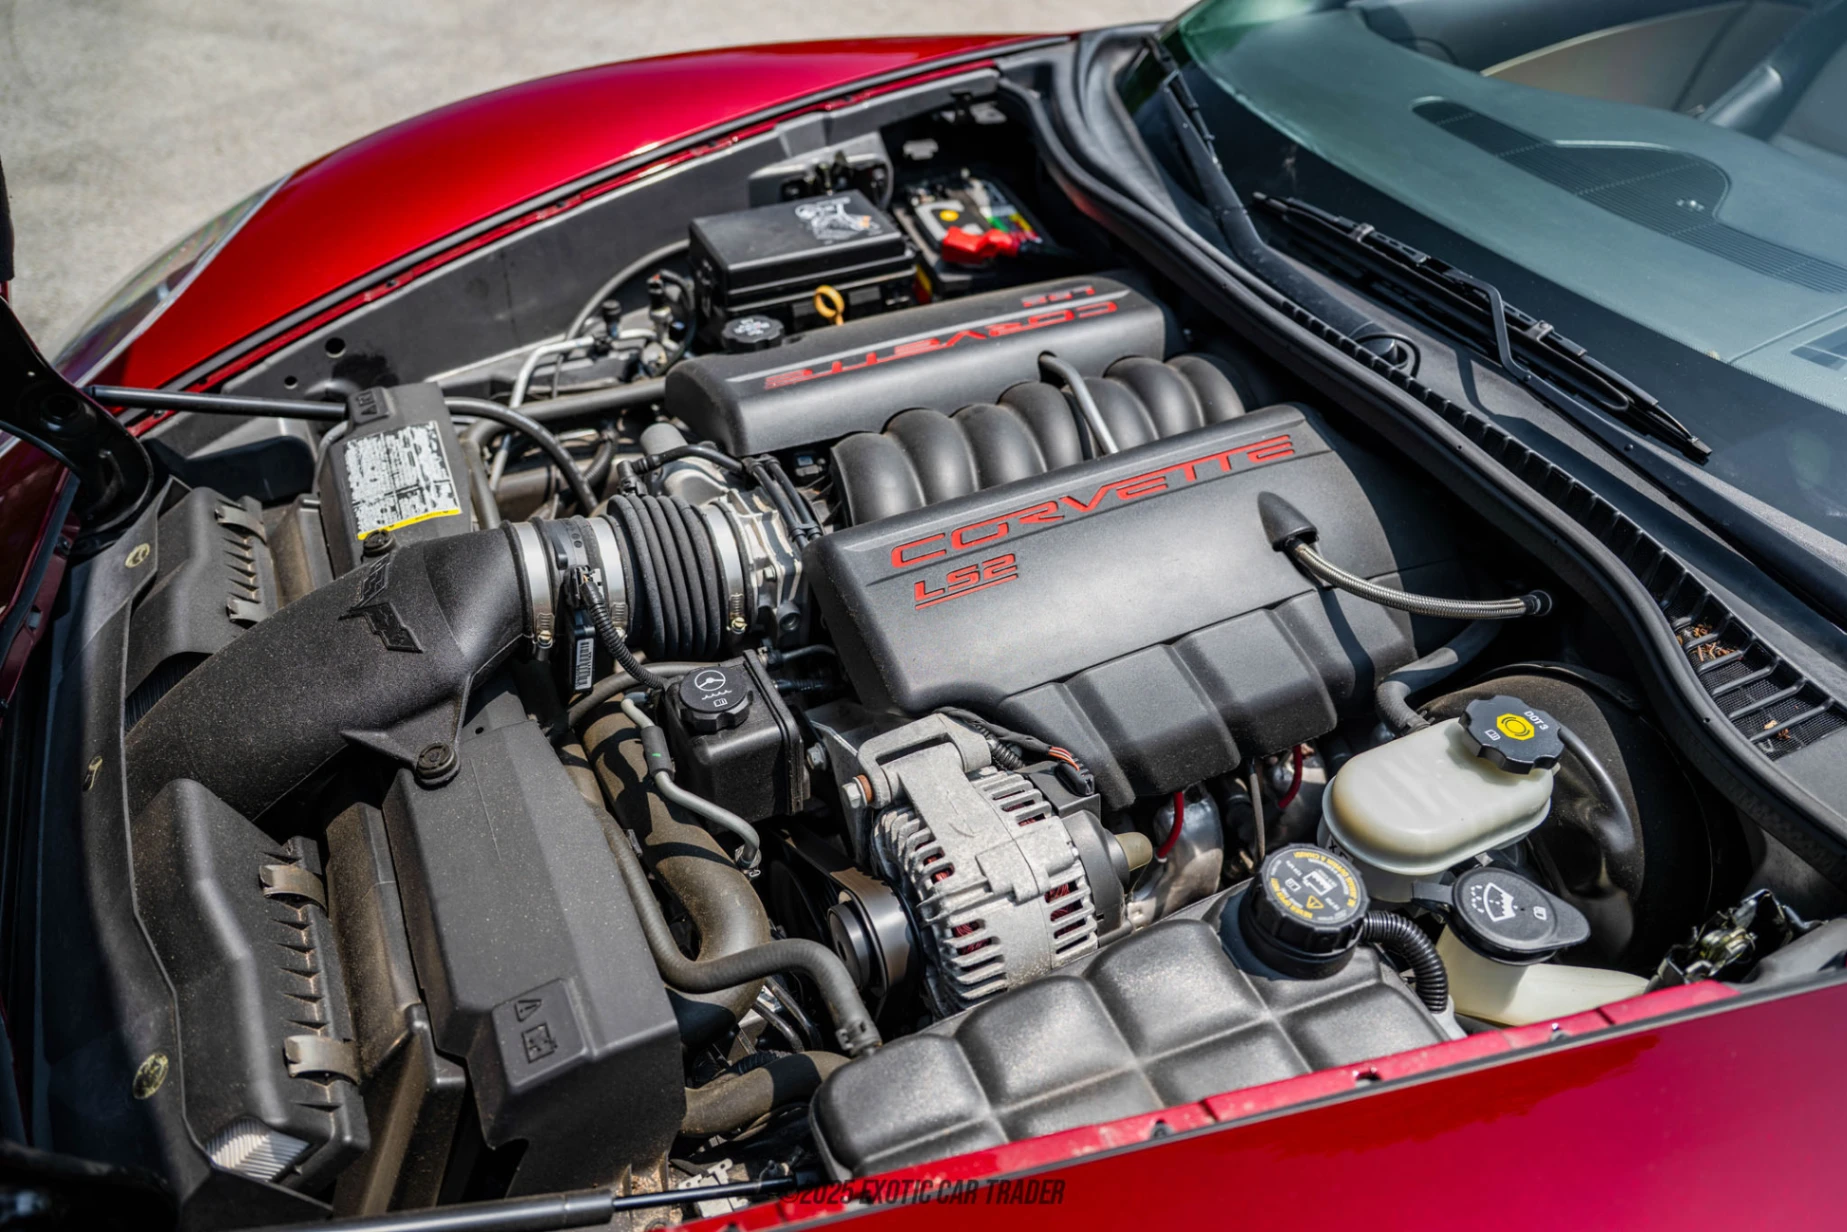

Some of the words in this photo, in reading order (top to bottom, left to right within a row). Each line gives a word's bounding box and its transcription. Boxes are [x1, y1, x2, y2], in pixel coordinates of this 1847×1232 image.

[764, 300, 1118, 390] CORVETTE
[891, 434, 1296, 569] CORVETTE
[914, 553, 1018, 604] LS2
[1524, 710, 1544, 725] DOT
